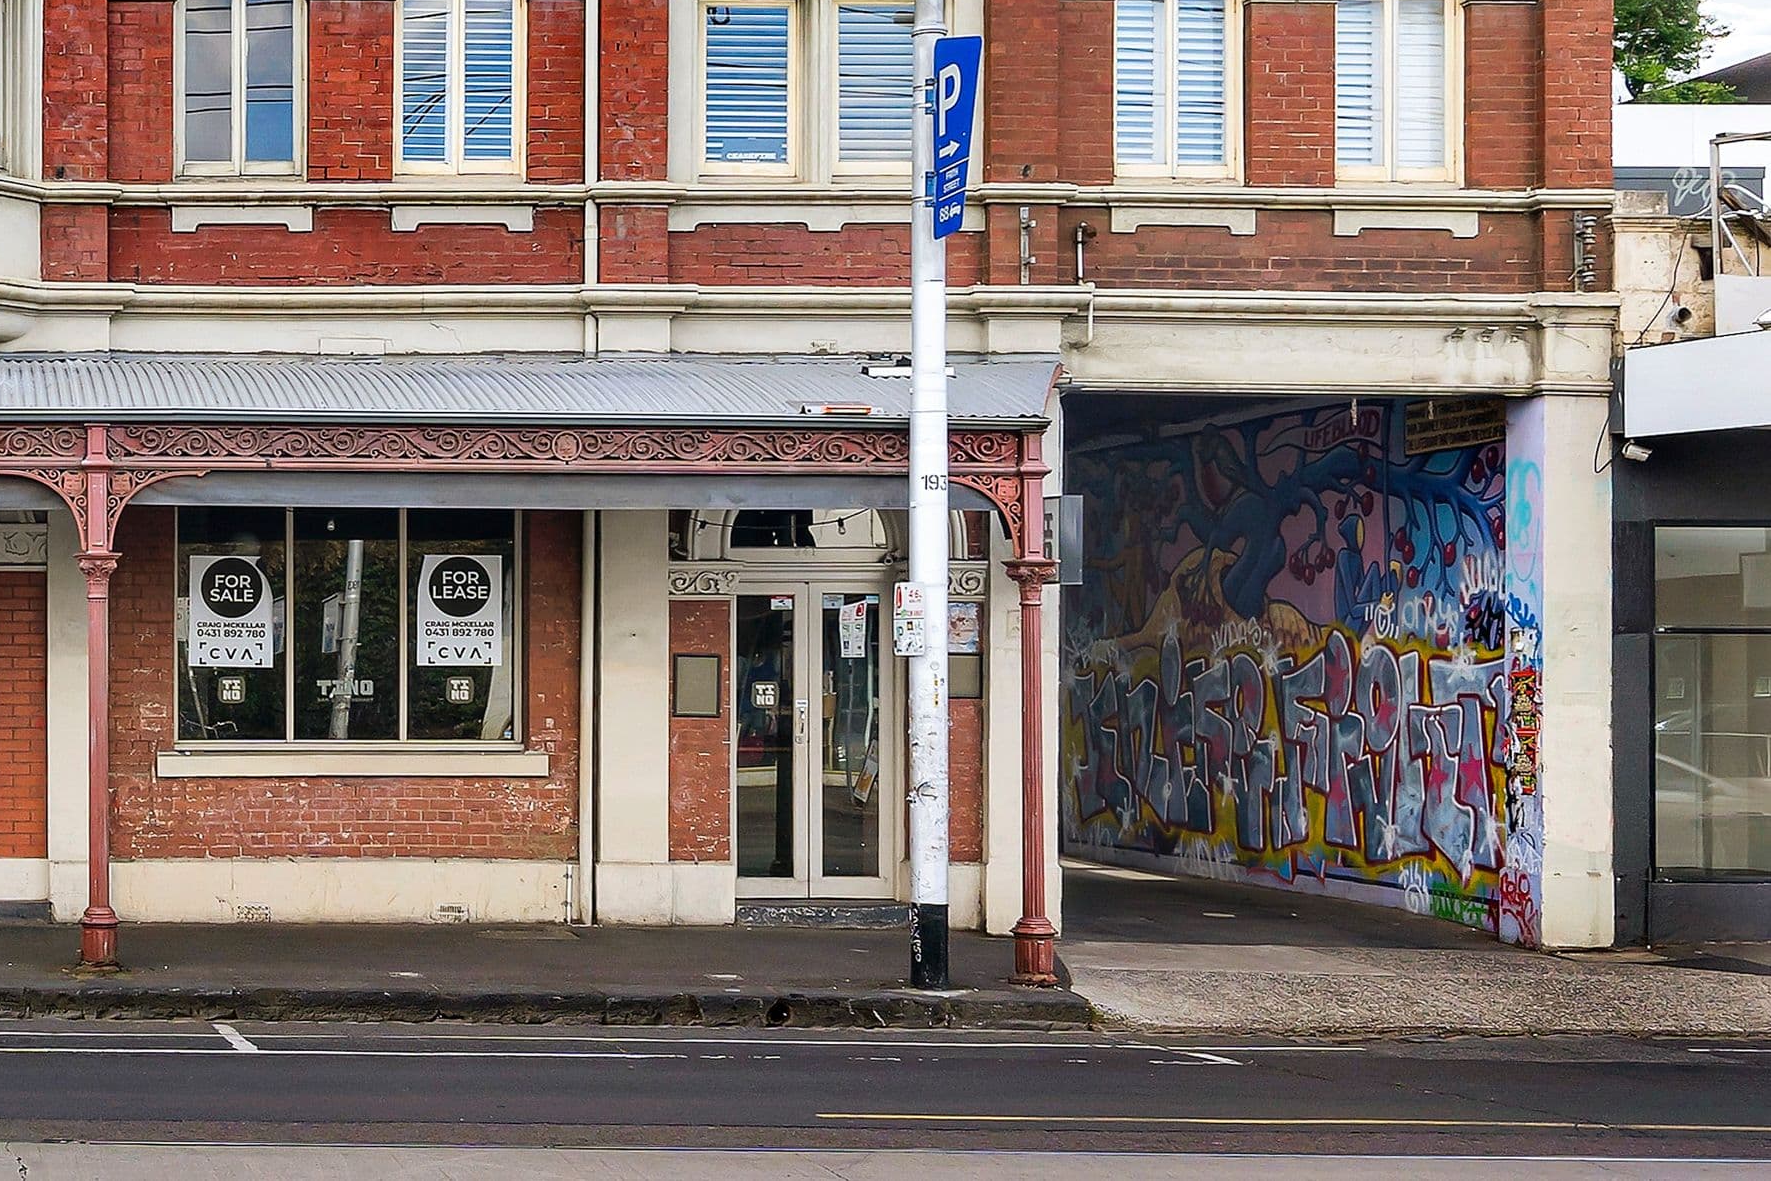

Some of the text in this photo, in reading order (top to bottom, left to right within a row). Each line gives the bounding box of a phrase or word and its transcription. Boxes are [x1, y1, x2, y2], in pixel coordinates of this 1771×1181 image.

[939, 63, 962, 137] P
[215, 575, 251, 588] FOR
[442, 571, 480, 584] FOR
[210, 589, 254, 602] SALE
[432, 585, 488, 599] LEASE
[196, 629, 266, 638] 0431 892 780
[425, 628, 494, 637] 0431 892 780
